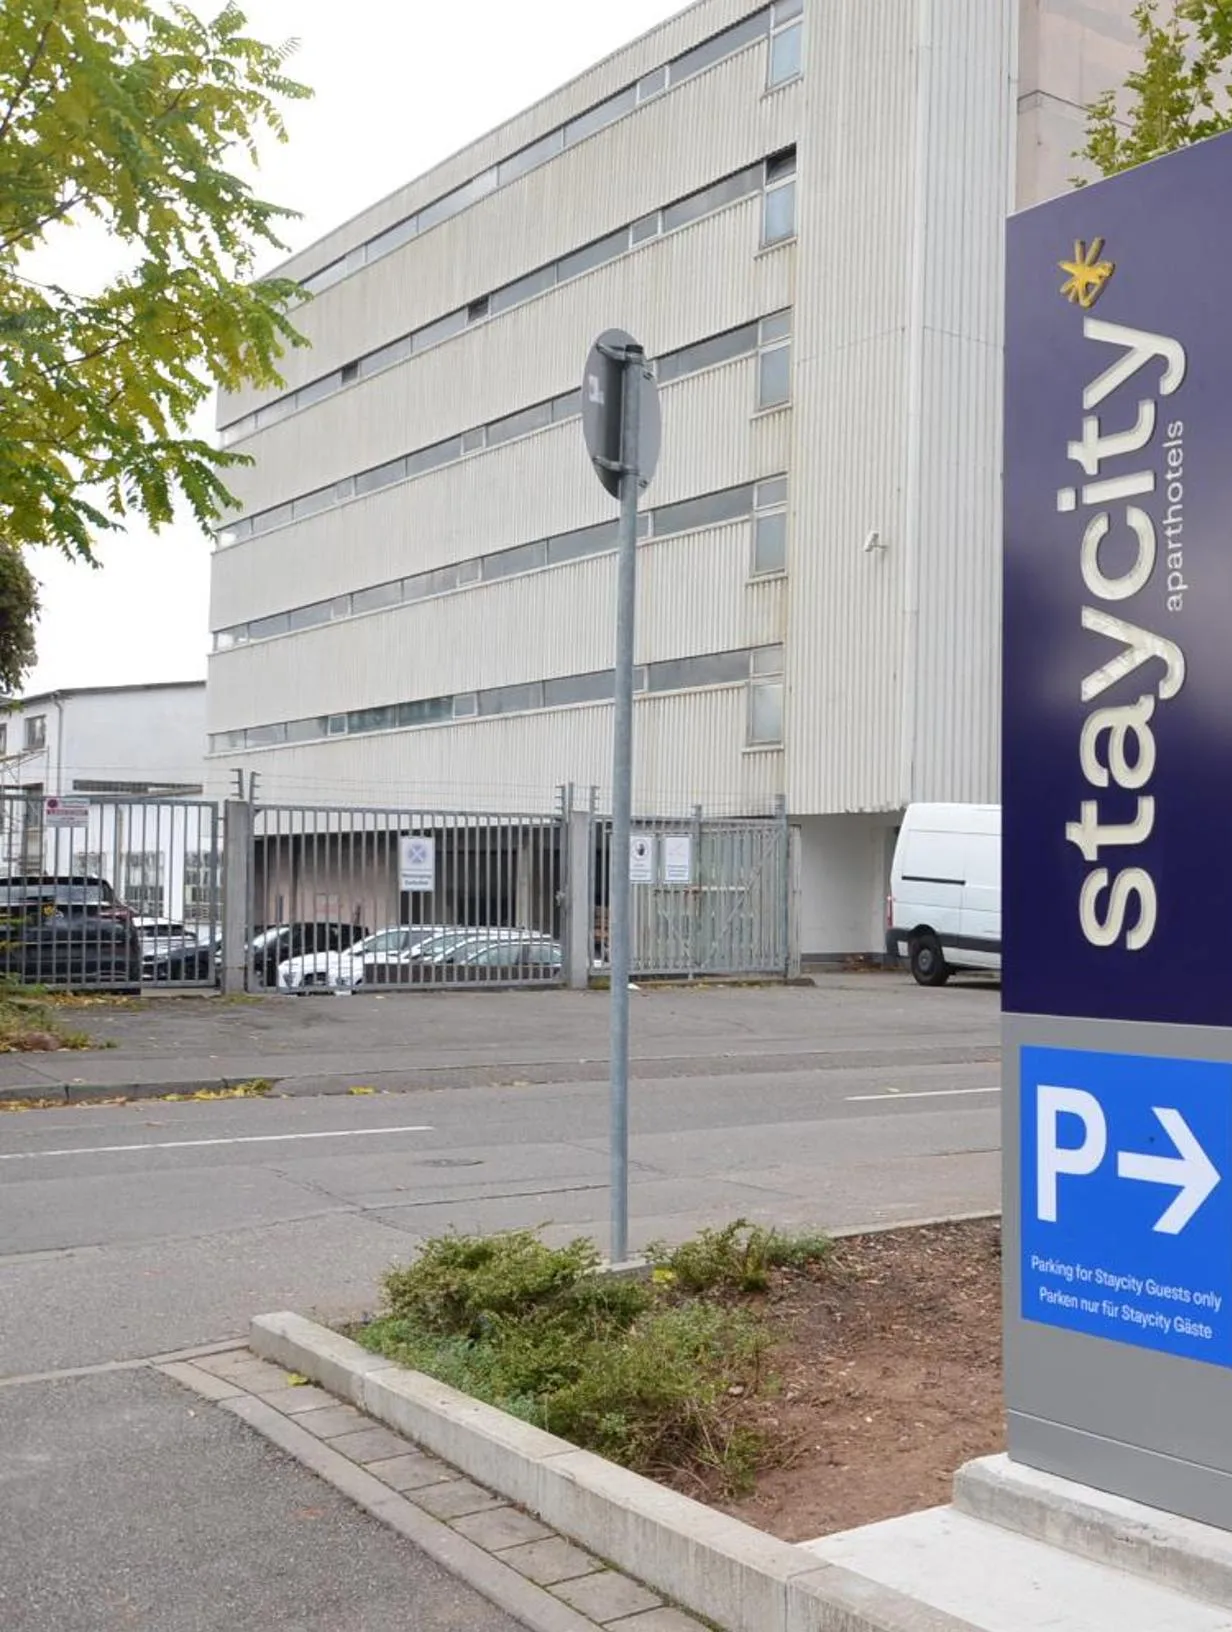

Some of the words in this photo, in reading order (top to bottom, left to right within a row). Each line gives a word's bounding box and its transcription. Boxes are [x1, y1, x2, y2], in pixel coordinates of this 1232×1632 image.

[1162, 420, 1189, 612] aparthotels
[1057, 317, 1187, 951] staycity
[1036, 1084, 1108, 1222] P
[1031, 1255, 1074, 1281] Parking
[1075, 1264, 1092, 1281] for
[1095, 1268, 1144, 1296] Staycity
[1145, 1279, 1191, 1304] Guests
[1193, 1291, 1222, 1312] only
[1039, 1287, 1078, 1309] Parken
[1080, 1298, 1100, 1314] nur
[1102, 1300, 1119, 1318] für
[1121, 1305, 1172, 1334] Staycity
[1174, 1316, 1213, 1339] Gäste
